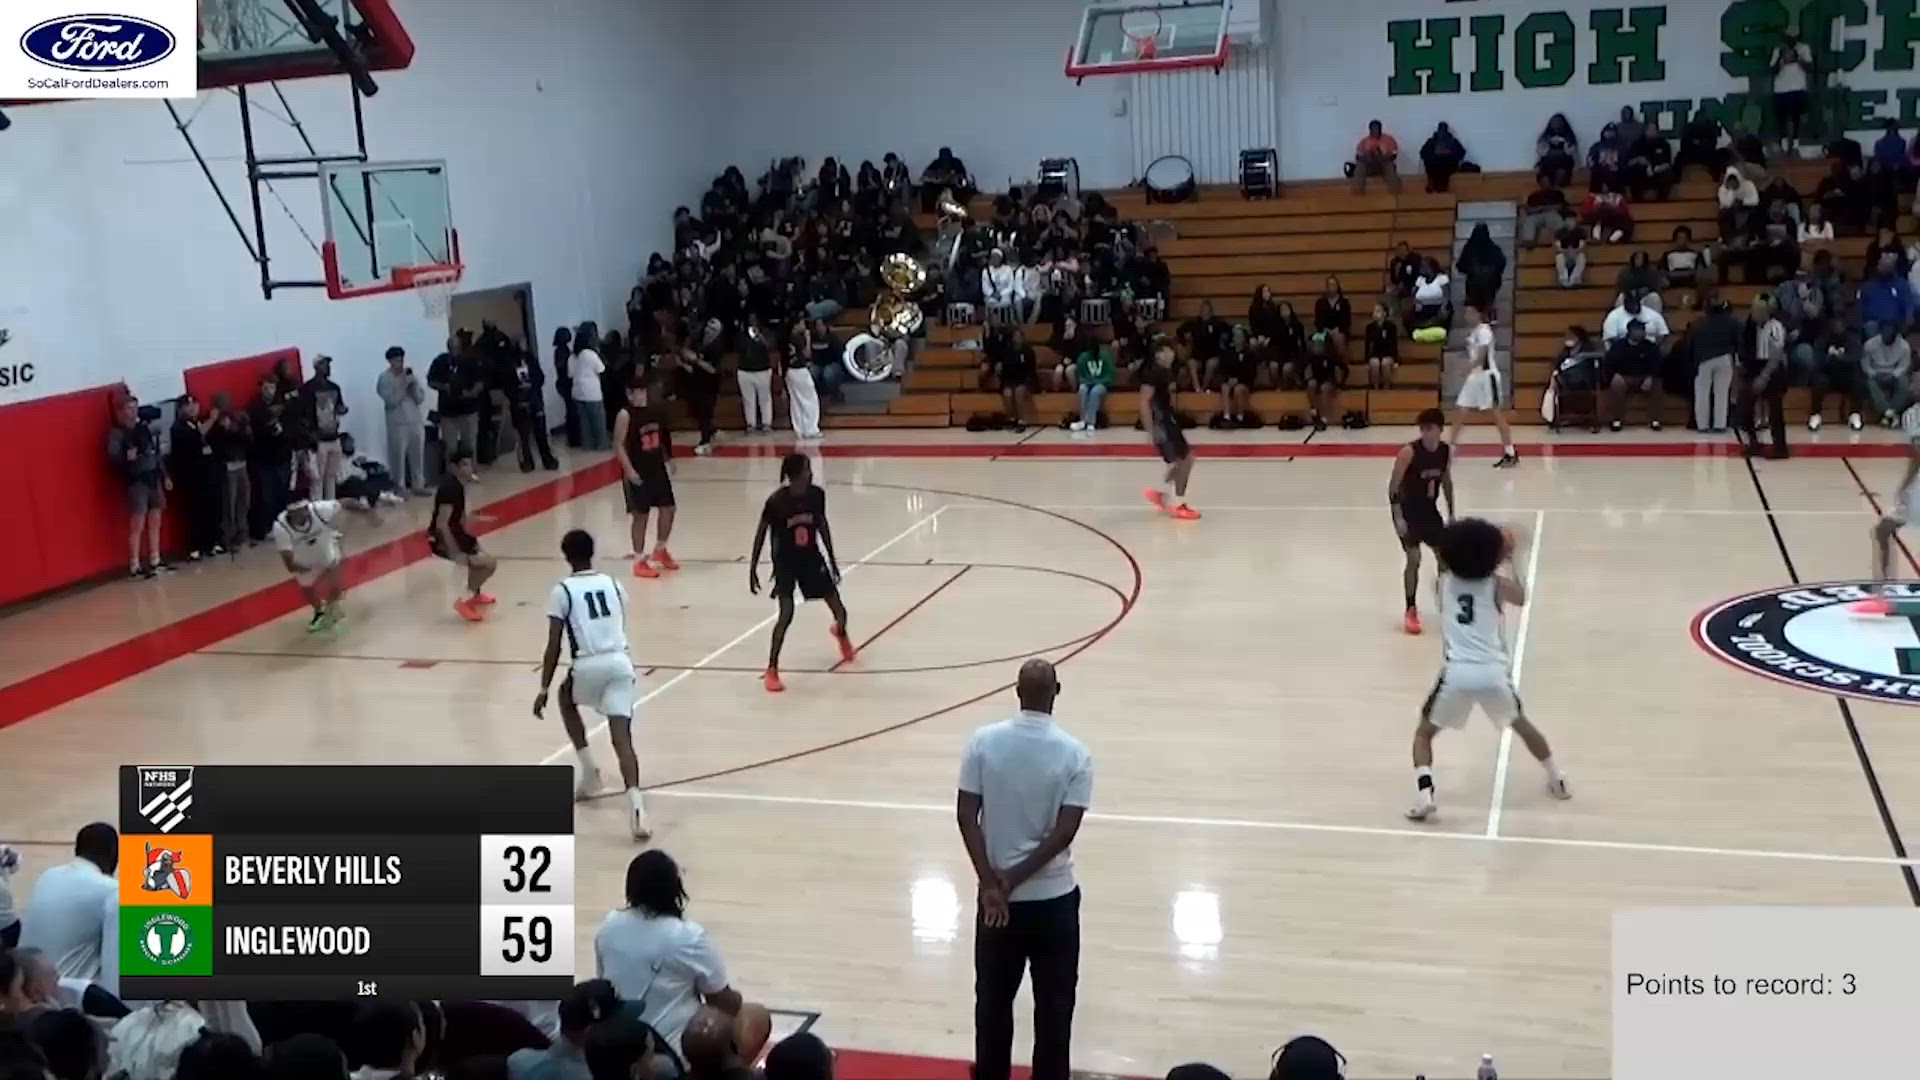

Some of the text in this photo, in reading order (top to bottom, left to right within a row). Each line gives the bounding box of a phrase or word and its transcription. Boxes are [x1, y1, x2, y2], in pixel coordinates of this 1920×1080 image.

[1388, 6, 1666, 96] HIGH
[584, 590, 611, 620] 11
[1457, 594, 1474, 624] 3
